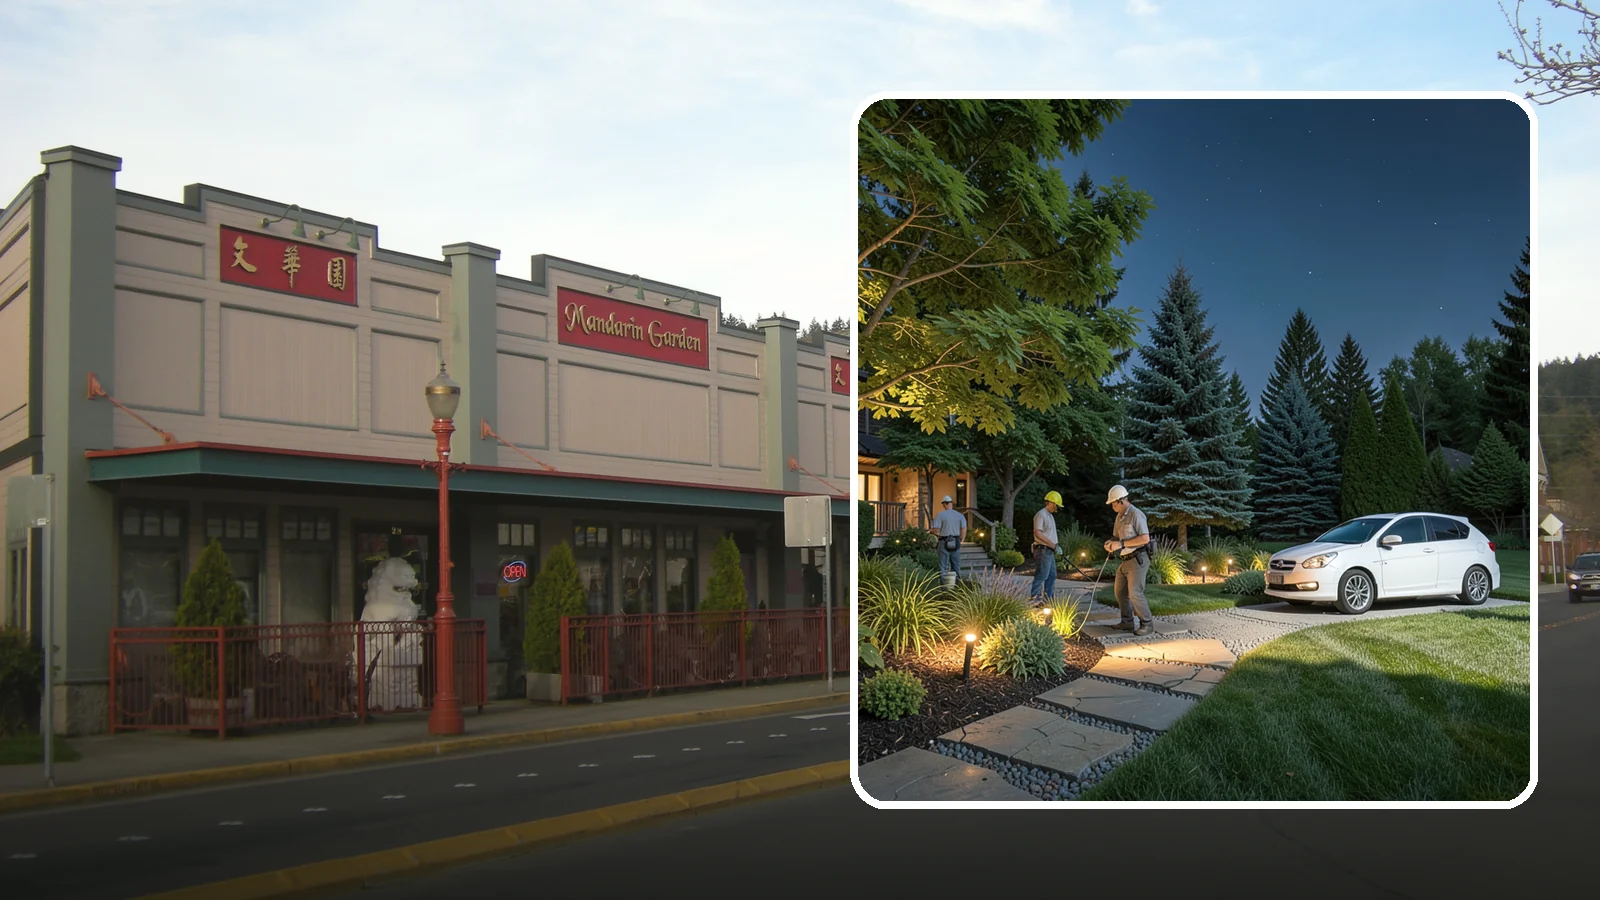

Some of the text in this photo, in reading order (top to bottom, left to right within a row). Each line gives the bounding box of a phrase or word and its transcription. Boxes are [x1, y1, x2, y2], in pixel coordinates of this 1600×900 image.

[230, 235, 347, 291] 文華園
[564, 302, 701, 352] Mandarin Garden
[835, 363, 846, 386] 文
[503, 565, 526, 577] OPEN
